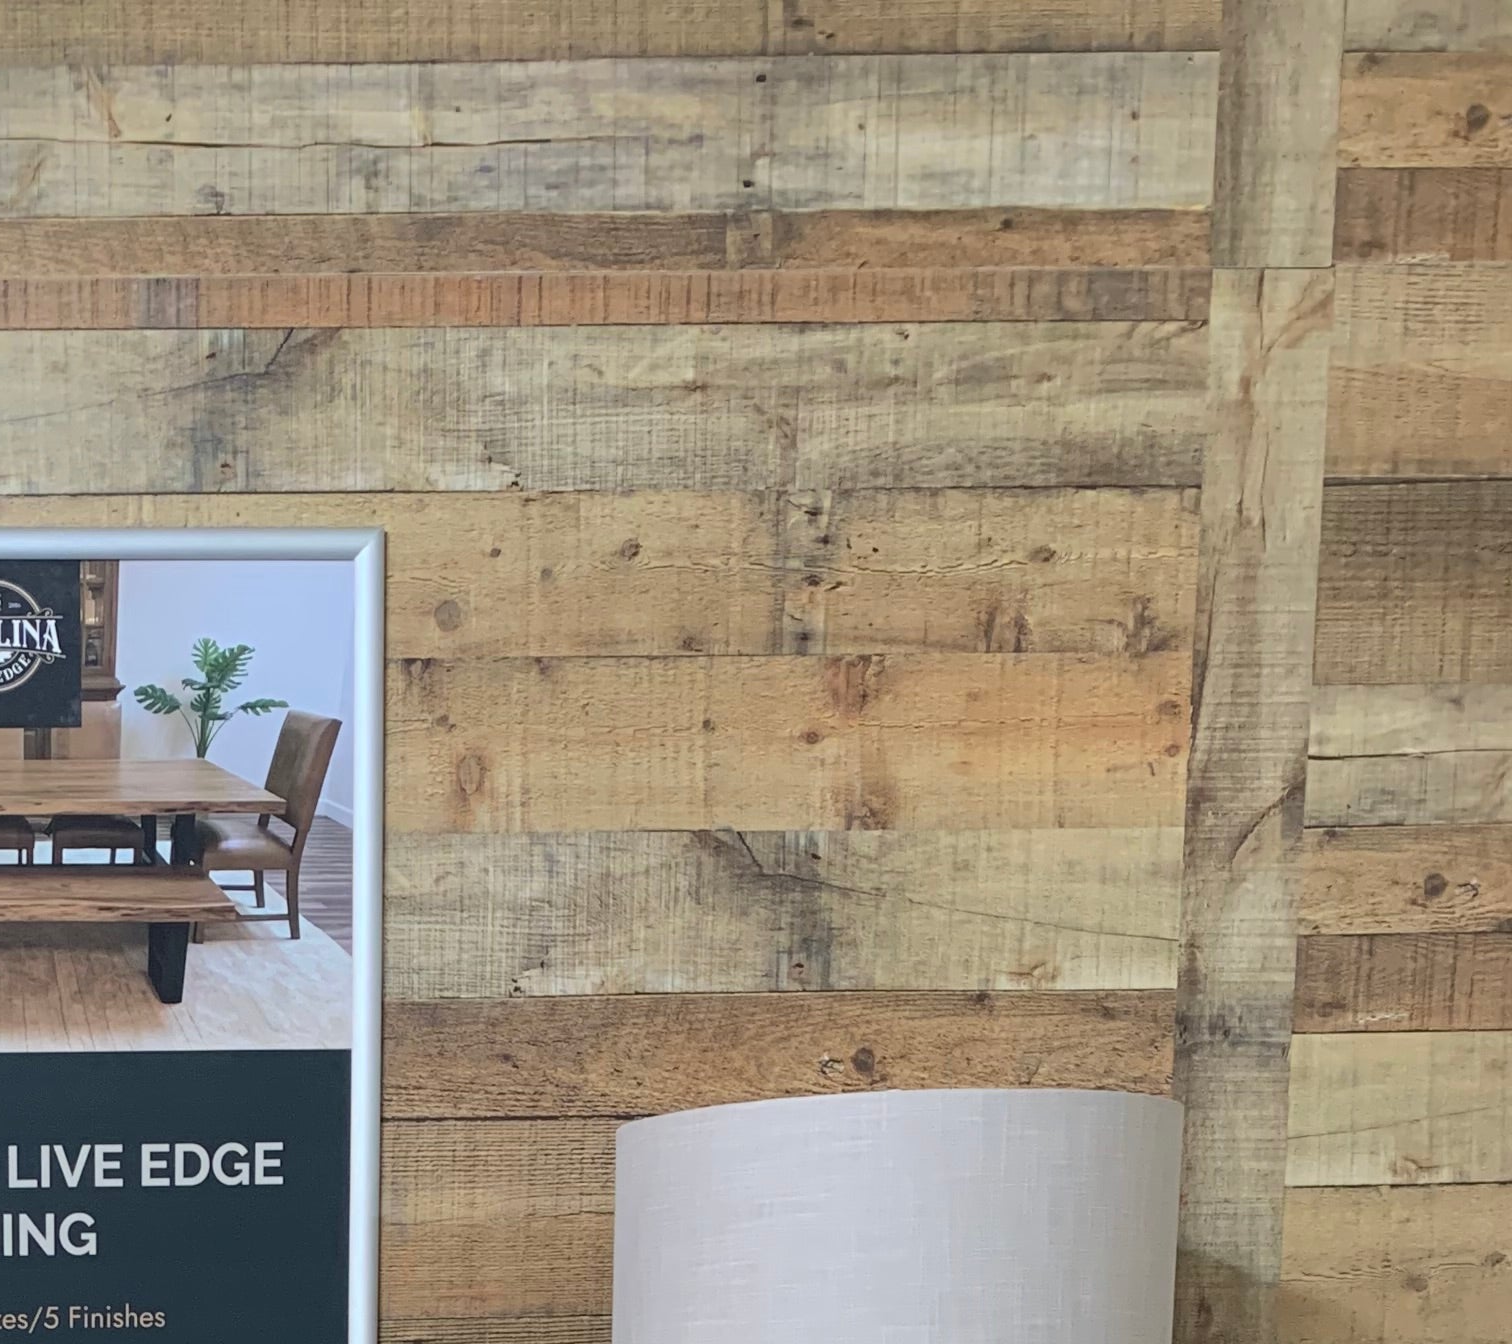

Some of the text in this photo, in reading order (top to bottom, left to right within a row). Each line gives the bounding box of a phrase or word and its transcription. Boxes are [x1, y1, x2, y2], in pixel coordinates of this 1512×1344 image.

[7, 1143, 124, 1189] LIVE
[141, 1141, 284, 1187] EDGE
[68, 1302, 166, 1329] Finishes
